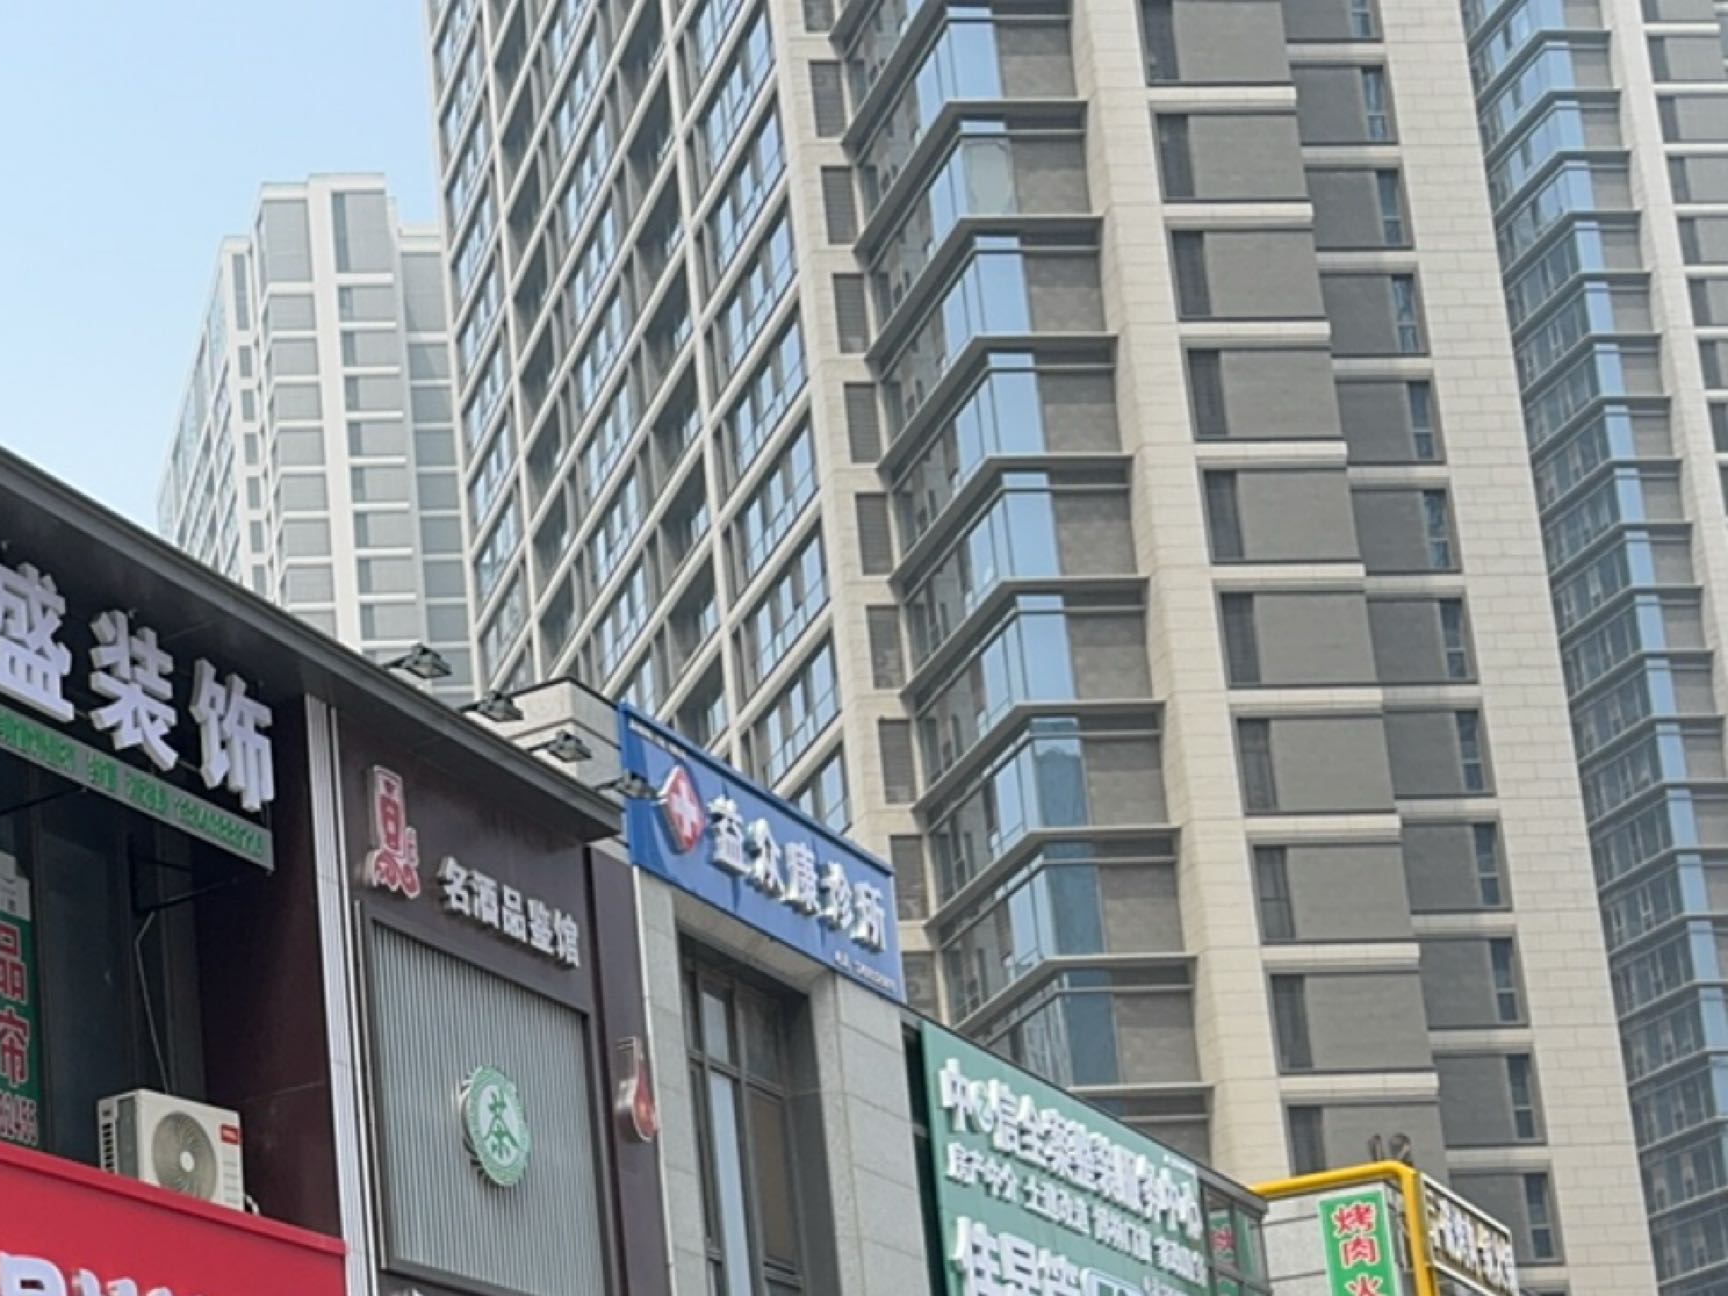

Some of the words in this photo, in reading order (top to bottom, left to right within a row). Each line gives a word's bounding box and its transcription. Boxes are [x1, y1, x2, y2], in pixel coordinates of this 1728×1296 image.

[707, 795, 886, 952] 益众康诊所
[484, 1089, 520, 1158] 茶
